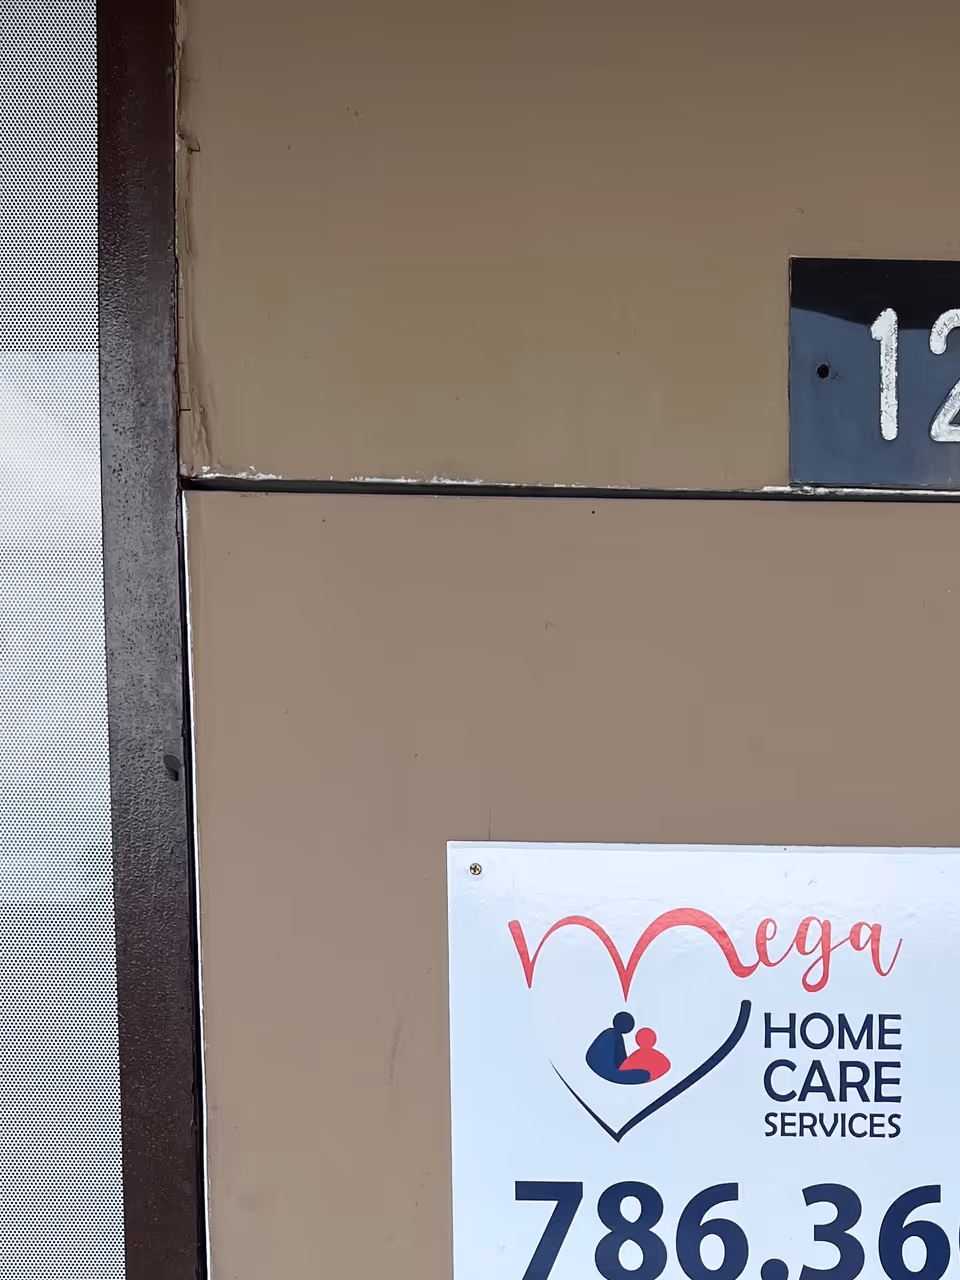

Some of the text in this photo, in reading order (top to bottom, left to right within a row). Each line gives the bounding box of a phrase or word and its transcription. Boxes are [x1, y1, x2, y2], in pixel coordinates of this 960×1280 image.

[763, 1012, 903, 1050] HOME
[763, 1059, 903, 1103] CARE
[763, 1111, 903, 1138] SERVICES
